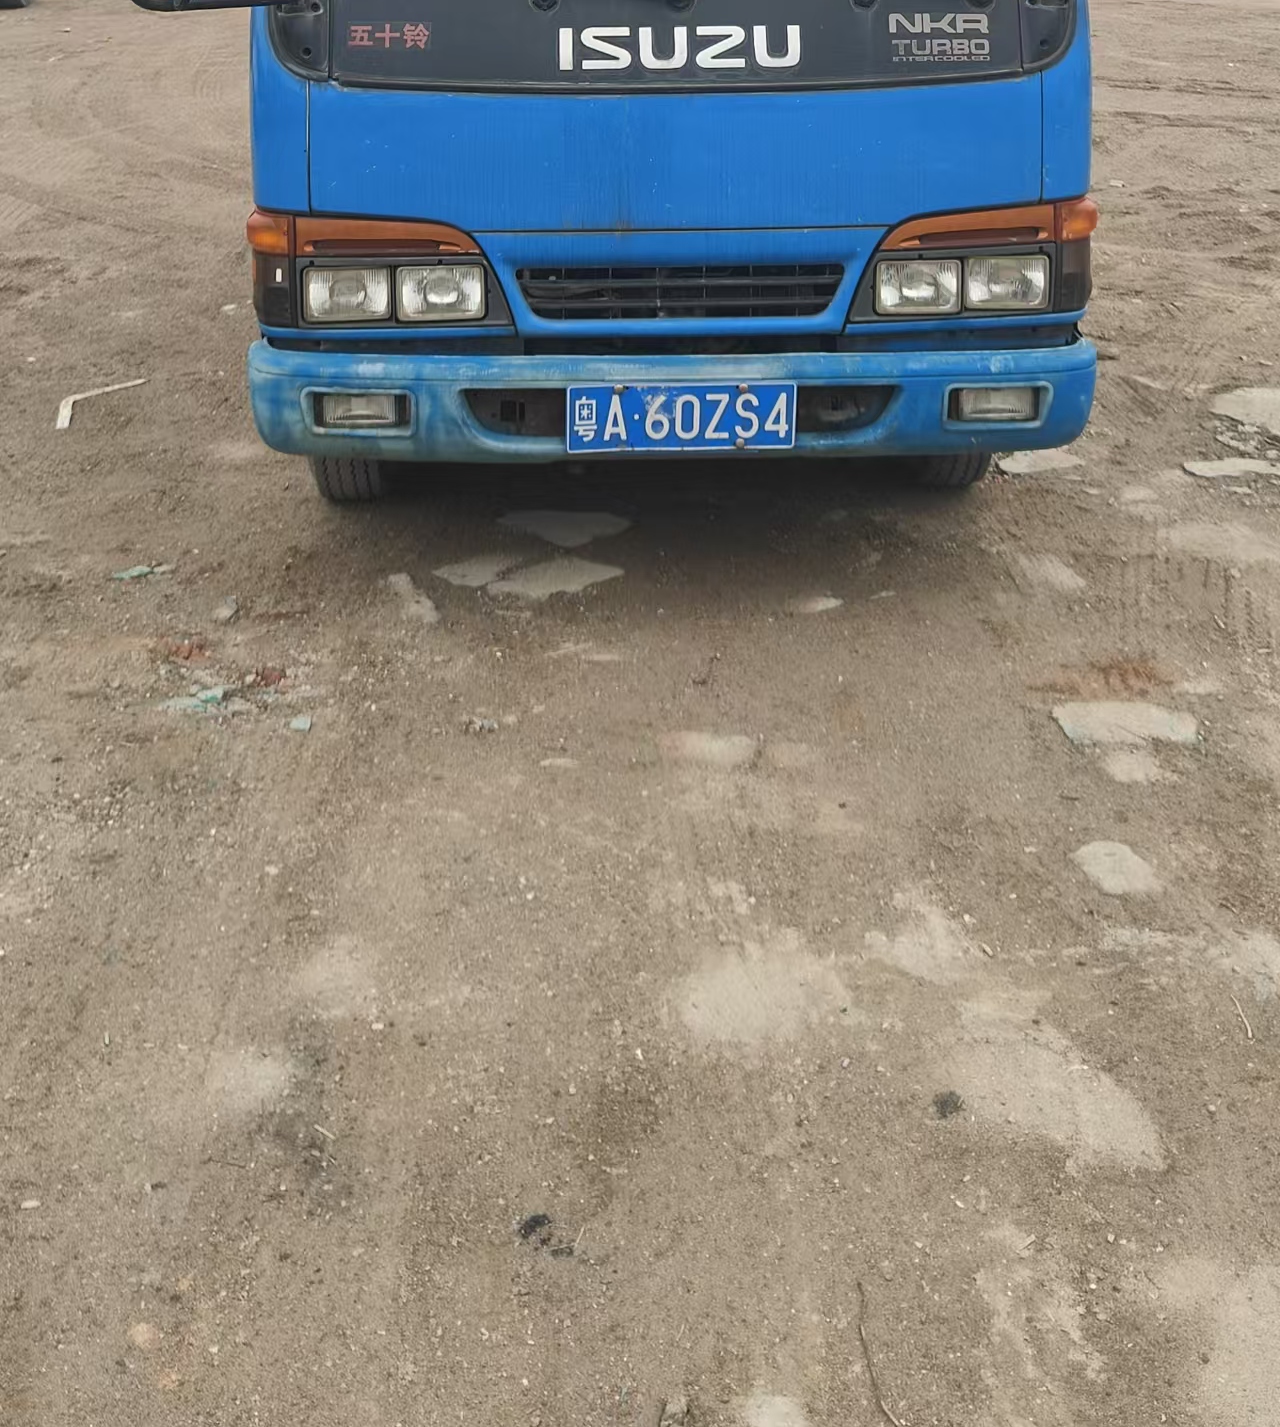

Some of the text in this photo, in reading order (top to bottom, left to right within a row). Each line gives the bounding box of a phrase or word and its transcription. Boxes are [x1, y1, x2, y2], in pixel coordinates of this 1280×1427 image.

[888, 13, 990, 34] NKR
[348, 23, 430, 49] 五十铃
[559, 25, 801, 70] ISUZU
[891, 39, 990, 55] TURBO
